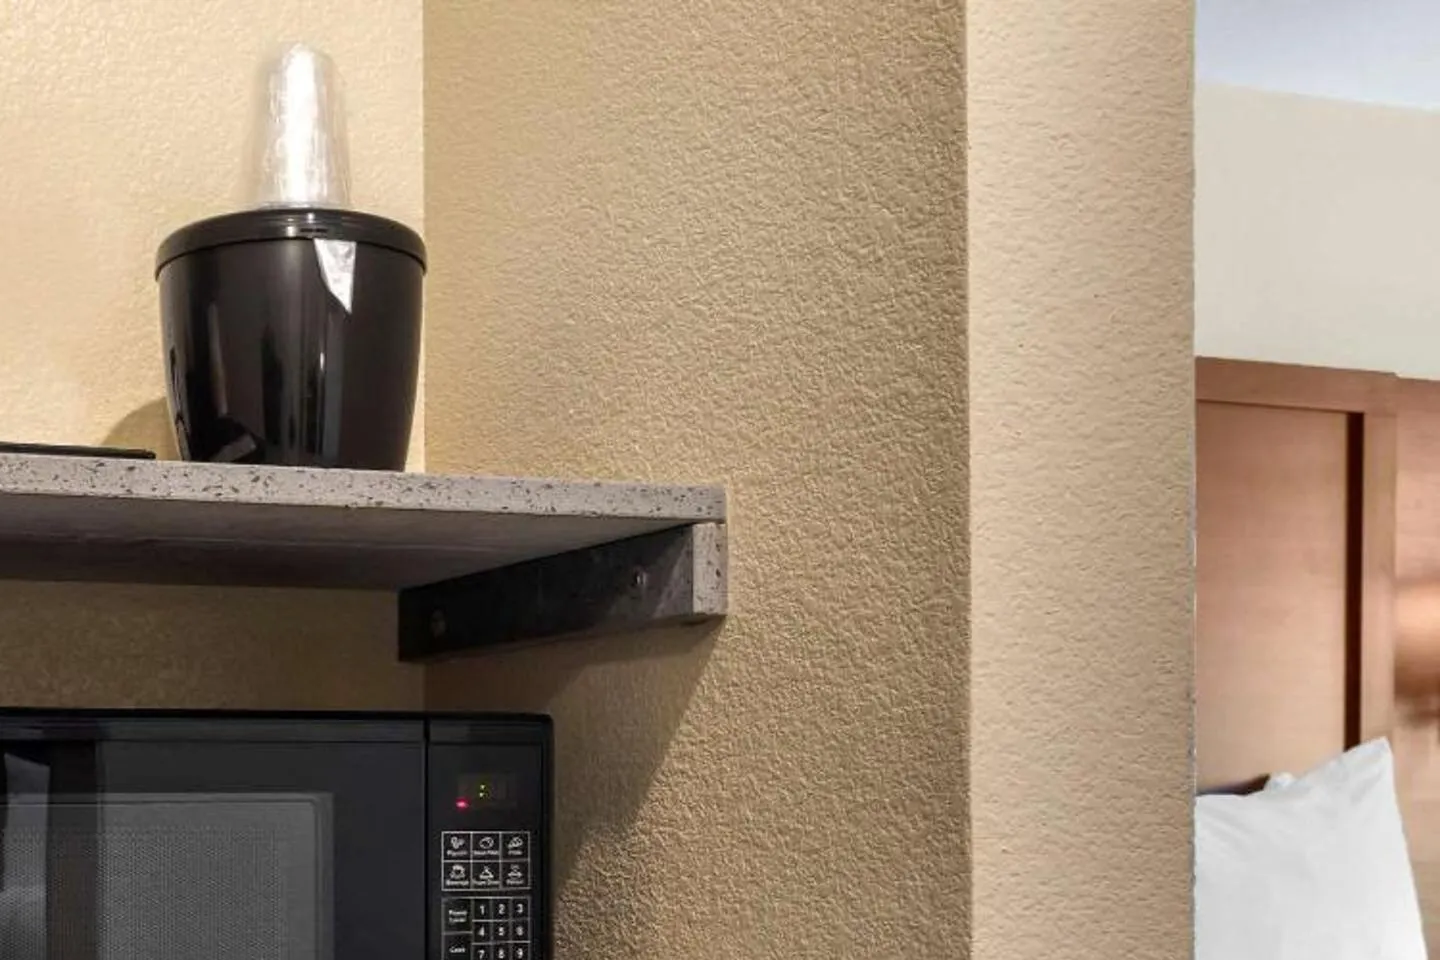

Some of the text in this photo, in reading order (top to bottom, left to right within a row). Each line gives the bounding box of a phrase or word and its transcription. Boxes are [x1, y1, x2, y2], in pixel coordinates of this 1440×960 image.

[479, 903, 524, 915] 1 2 3
[478, 926, 485, 937] 4
[478, 949, 485, 960] 7
